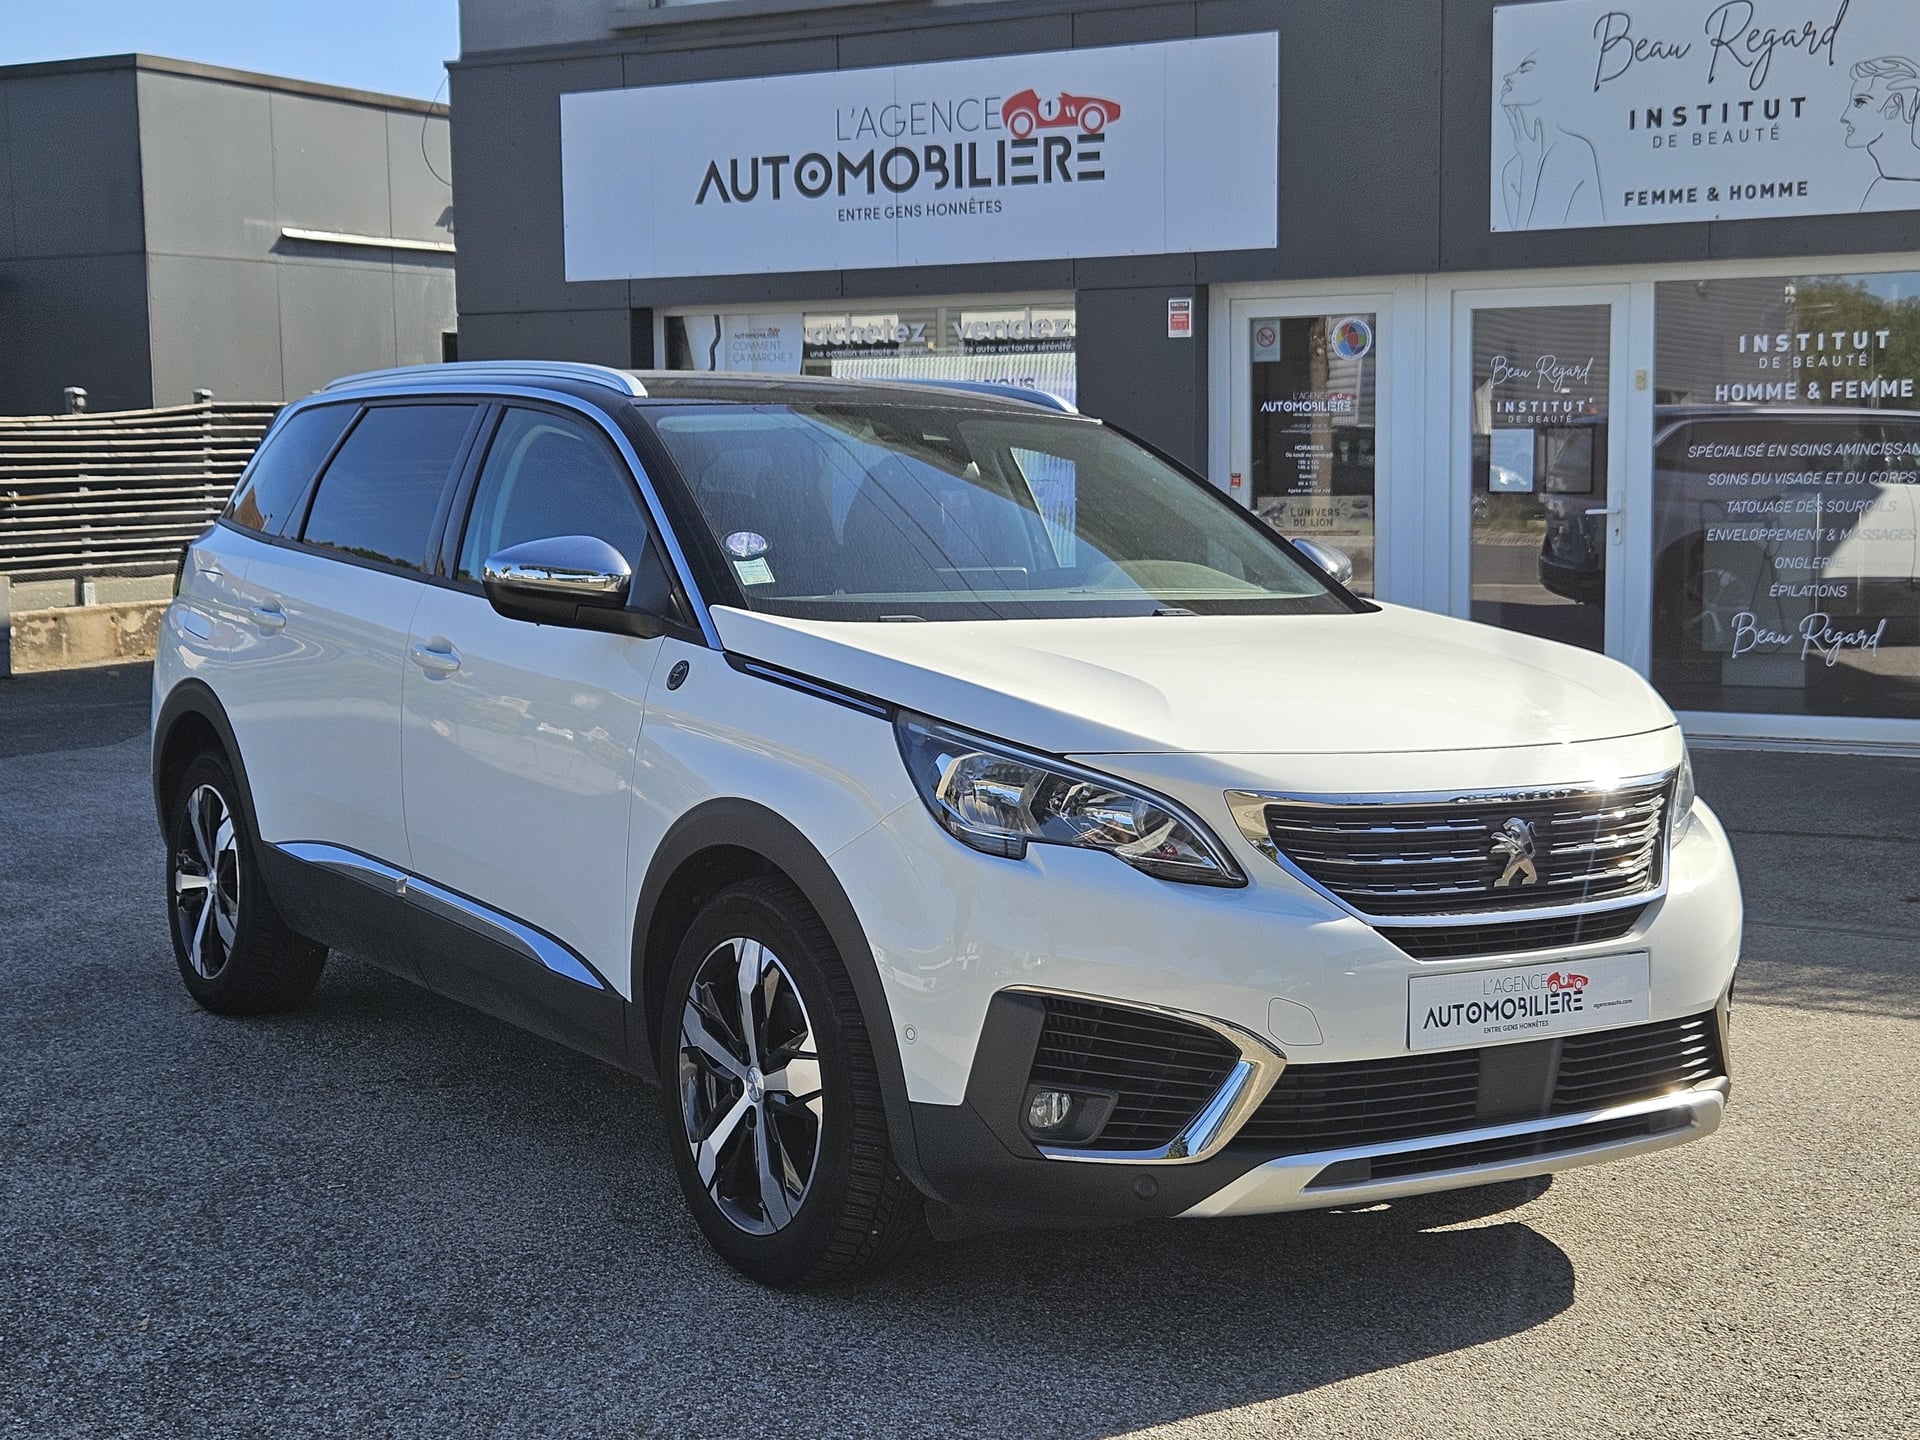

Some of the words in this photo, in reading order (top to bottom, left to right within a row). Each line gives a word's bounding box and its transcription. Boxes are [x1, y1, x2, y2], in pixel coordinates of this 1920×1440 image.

[1593, 12, 1692, 93] Beau
[1704, 0, 1849, 90] Regard
[836, 96, 1001, 141] L'AGENCE
[1629, 97, 1807, 130] INSTITUT
[1652, 134, 1678, 149] DE
[1692, 124, 1781, 146] BEAUTÉ
[1623, 188, 1698, 207] FEMME
[1706, 186, 1721, 202] &
[1729, 181, 1808, 200] HOMME
[837, 207, 880, 222] ENTRE
[885, 205, 922, 220] GENS
[926, 199, 1003, 218] HONNÊTES
[810, 314, 927, 345] achetez
[952, 310, 1070, 340] vendez
[732, 340, 781, 351] COMMENT
[976, 344, 996, 353] auto
[998, 344, 1009, 353] en
[1011, 341, 1034, 352] toute
[1739, 330, 1890, 353] INSTITUT
[810, 349, 824, 358] une
[1759, 357, 1781, 369] DE
[1792, 351, 1867, 368] BEAUTÉ
[1490, 355, 1532, 389] Beau
[1535, 354, 1594, 393] Regard
[1715, 381, 1797, 401] HOMME
[1807, 382, 1820, 399] &
[1831, 378, 1914, 398] FEMME
[1496, 401, 1585, 413] INSTITUT
[1527, 414, 1572, 423] BEAUTÉ
[1687, 442, 1765, 458] SPÉCIALISÉ
[1767, 445, 1787, 457] EN
[1789, 443, 1832, 456] SOINS
[1707, 473, 1748, 486] SOINS
[1751, 473, 1772, 486] DU
[1774, 473, 1822, 486] VISAGE
[1824, 472, 1843, 485] ET
[1845, 471, 1866, 485] DU
[1868, 471, 1917, 485] CORPS
[1727, 500, 1792, 513] TATOUAGE
[1795, 500, 1823, 513] DES
[1825, 500, 1897, 513] SOURCILS
[1293, 519, 1306, 528] DU
[1310, 518, 1334, 528] LION
[1706, 528, 1825, 542] ENVELOPPEMENT
[1827, 529, 1836, 541] &
[1839, 528, 1917, 541] MASSAGES
[1774, 557, 1845, 570] ONGLERIE
[1769, 582, 1848, 598] ÉPILATIONS
[1731, 612, 1792, 659] Beau
[1799, 612, 1887, 667] Regard
[1483, 973, 1548, 996] L'AGENCE
[1483, 1025, 1502, 1034] ENTRE
[1503, 1022, 1519, 1032] GENS
[1519, 1018, 1549, 1030] HONNÊTES
